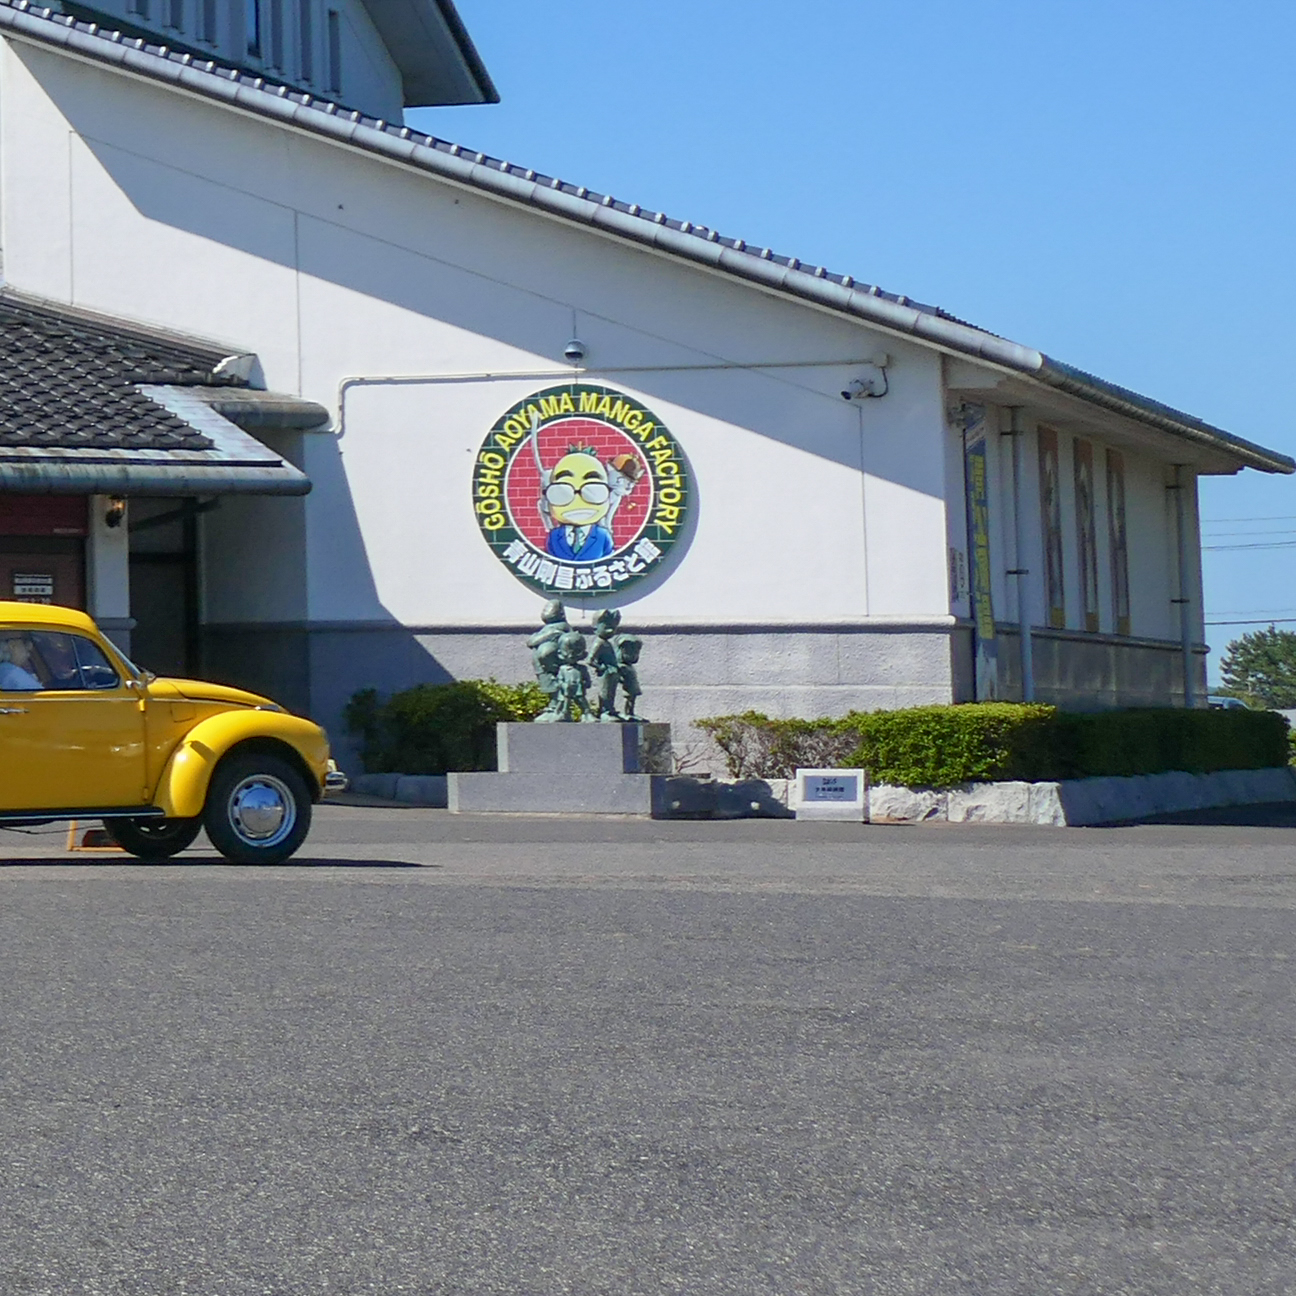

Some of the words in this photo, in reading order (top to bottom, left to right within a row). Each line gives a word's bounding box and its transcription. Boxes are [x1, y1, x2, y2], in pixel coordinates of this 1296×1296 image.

[476, 451, 506, 531] GŌSHŌ
[495, 392, 575, 452] AOYAMA
[579, 391, 655, 442] MANGA
[646, 435, 682, 535] FACTORY
[502, 537, 662, 589] 青山剛昌ふるさと館
